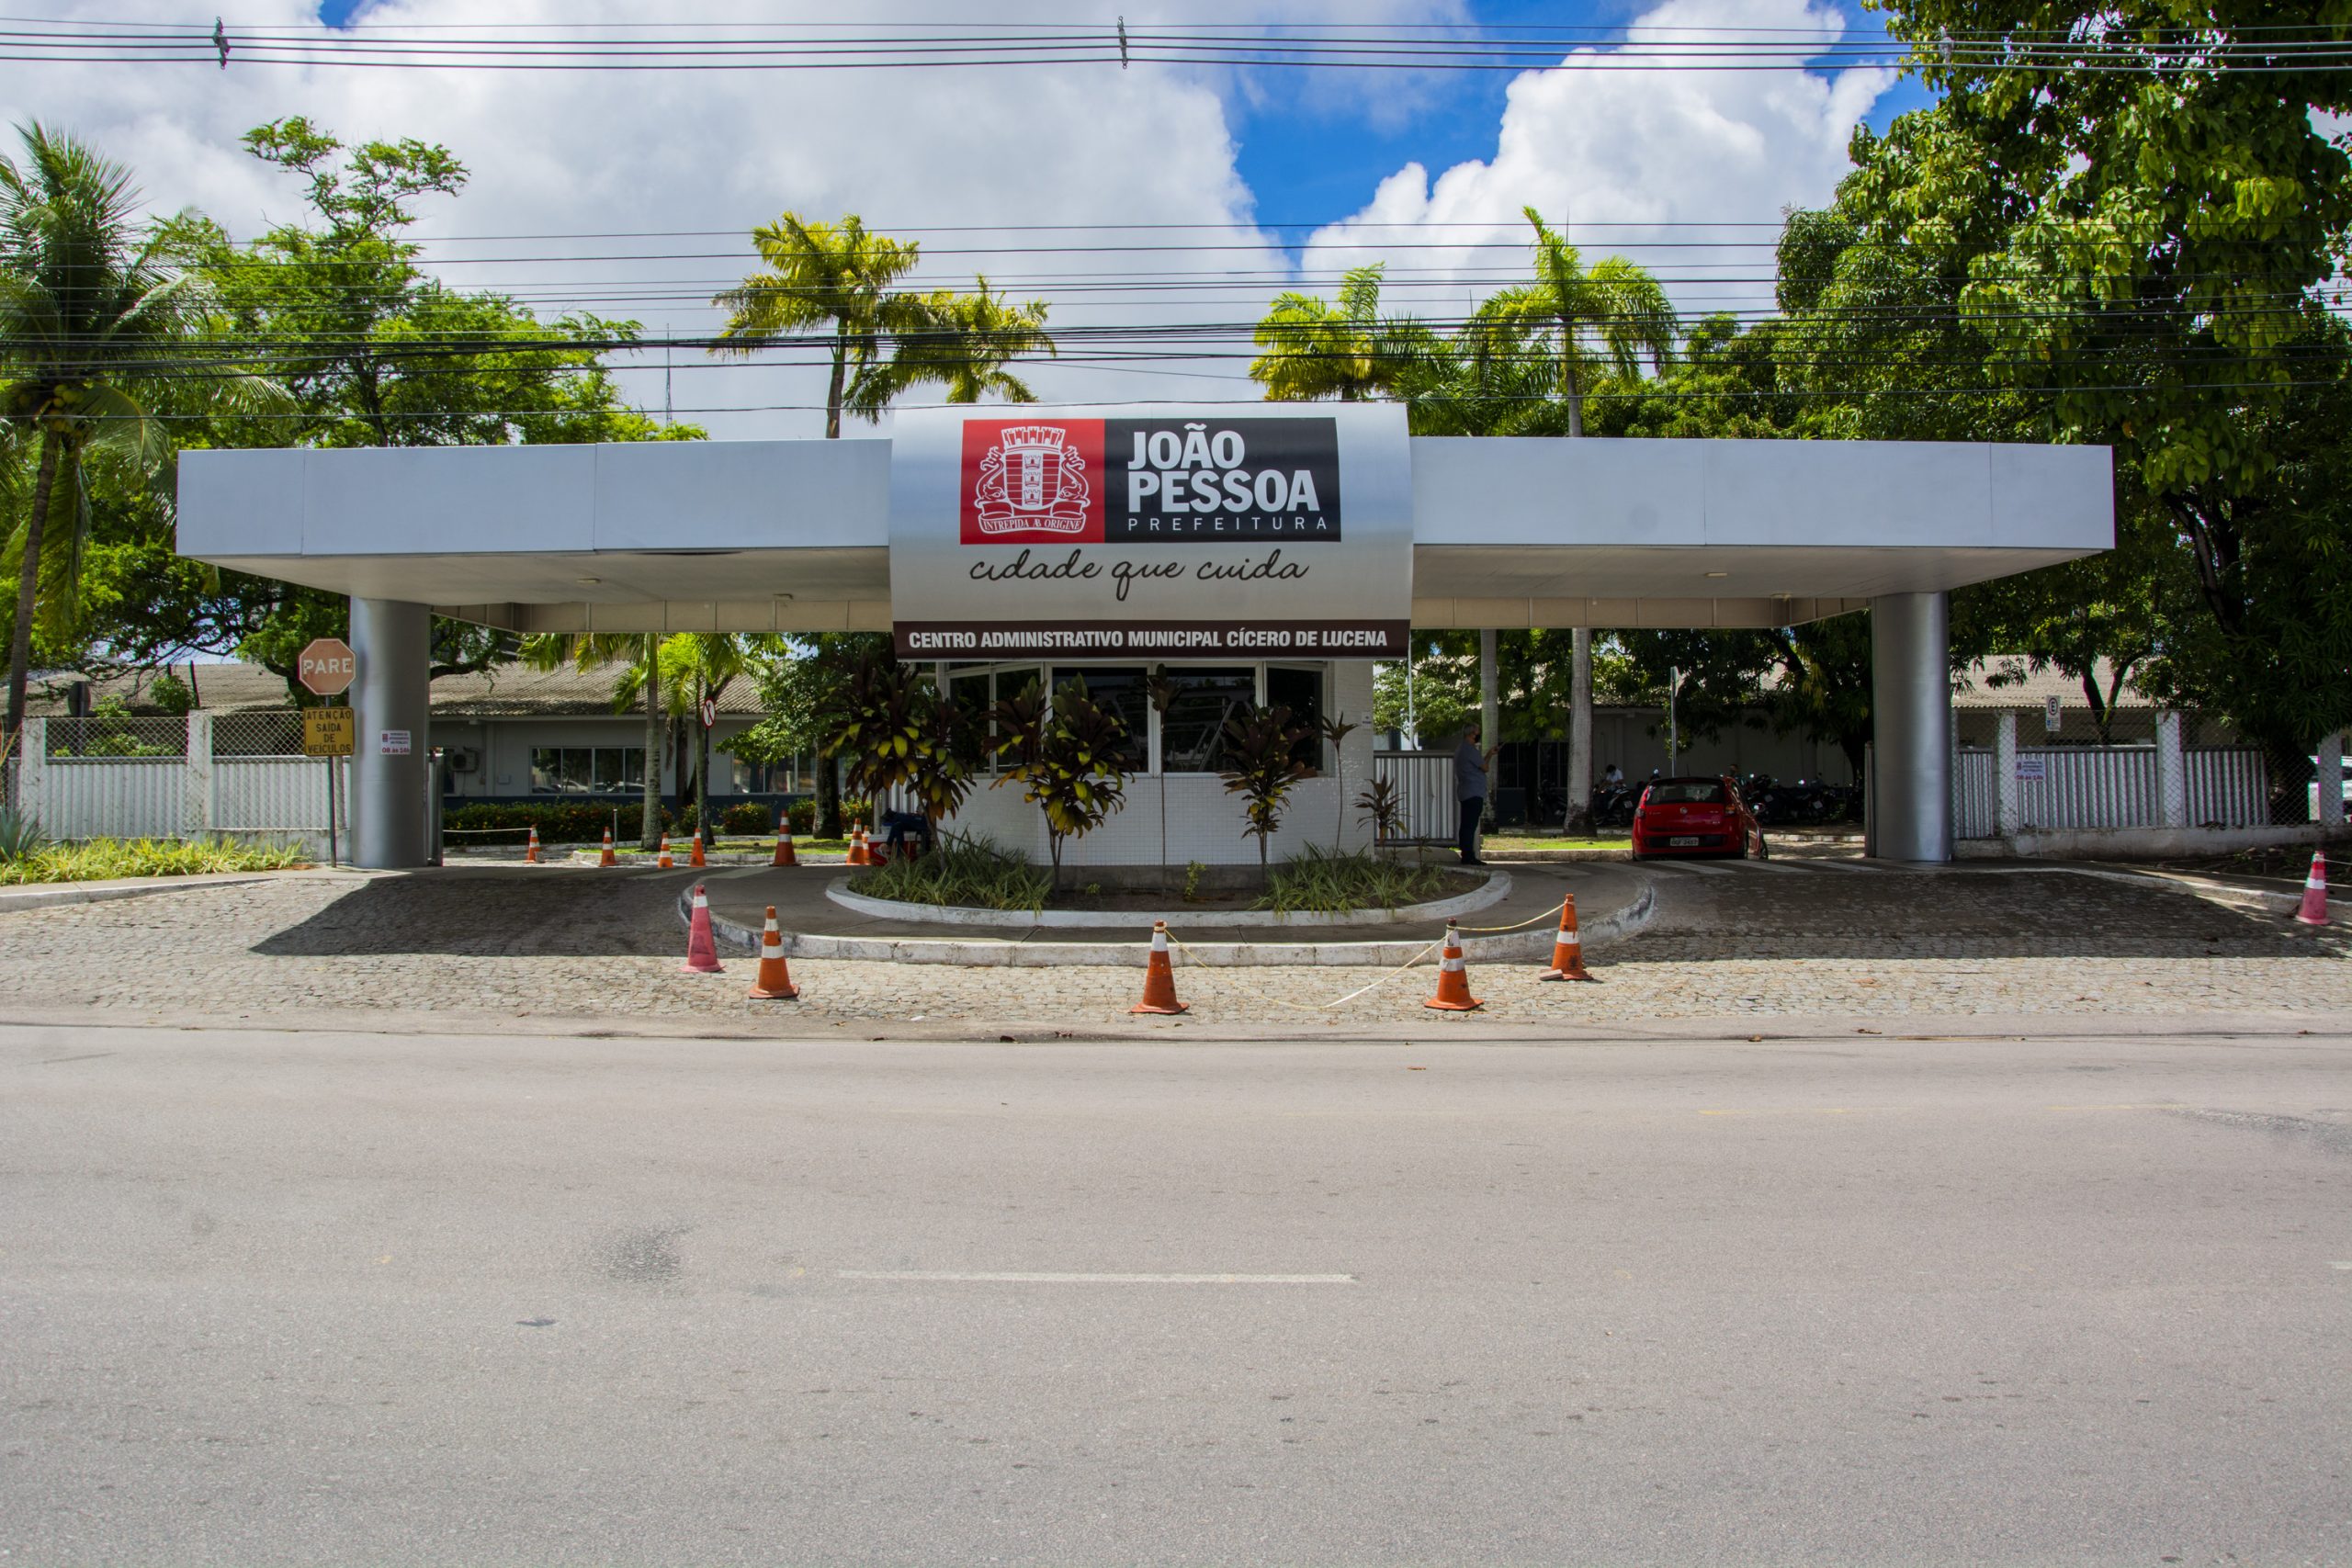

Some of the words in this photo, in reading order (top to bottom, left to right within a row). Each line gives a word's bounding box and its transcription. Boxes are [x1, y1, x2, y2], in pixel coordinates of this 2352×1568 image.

[1127, 422, 1245, 470] JOÃO
[1127, 468, 1320, 513] PESSOA
[983, 518, 1030, 531] INTREPIDA
[1044, 518, 1082, 531] ORIGINE
[1127, 516, 1327, 531] PREFEITURA
[969, 547, 1103, 581] cidade
[1111, 560, 1186, 602] que
[1196, 547, 1309, 581] cuida
[908, 631, 977, 649] CENTRO
[980, 630, 1124, 649] ADMINISTRATIVO
[1127, 630, 1223, 648] MUNICIPAL
[1227, 626, 1291, 647] CÍCERO
[1295, 630, 1317, 647] DE
[1321, 630, 1388, 647] LUCENA
[303, 658, 353, 675] PARE
[316, 722, 341, 732] SAÍDA
[324, 734, 335, 743] DE
[308, 743, 351, 753] VEÍCULOS
